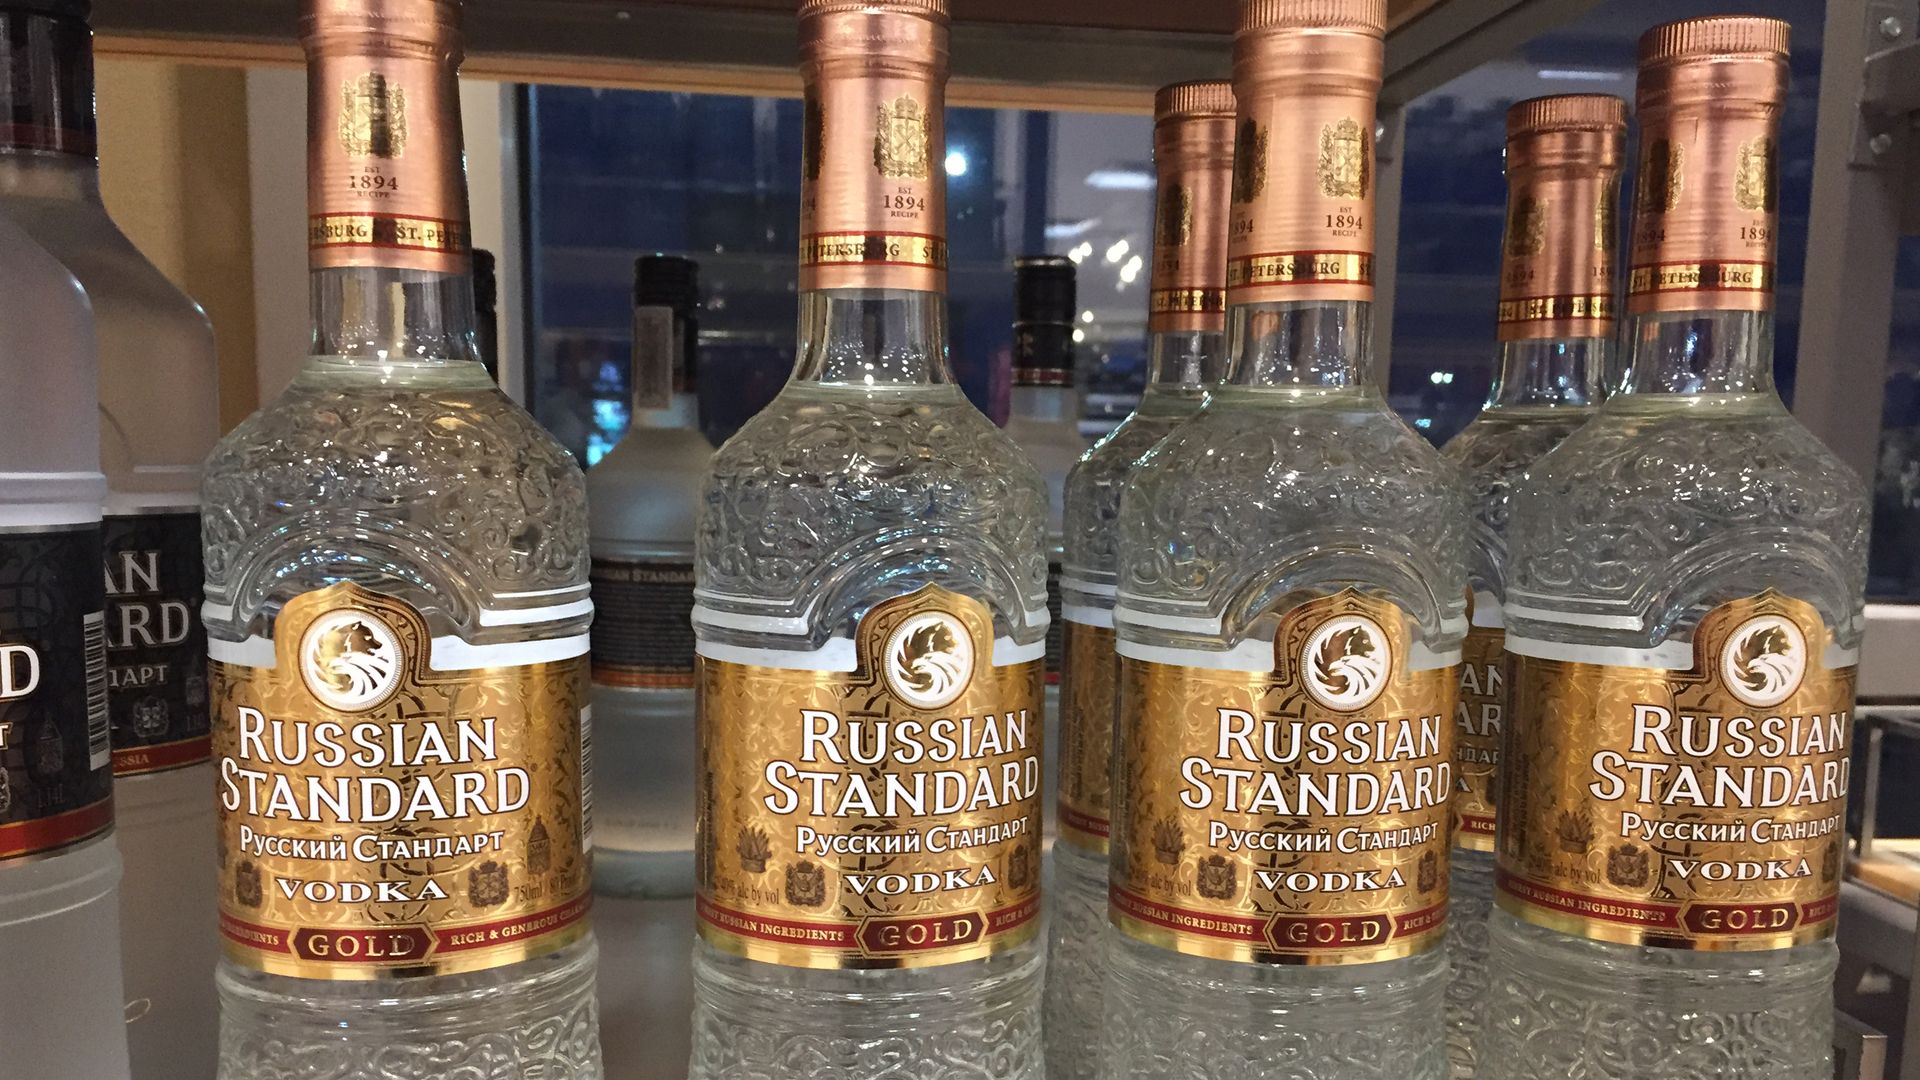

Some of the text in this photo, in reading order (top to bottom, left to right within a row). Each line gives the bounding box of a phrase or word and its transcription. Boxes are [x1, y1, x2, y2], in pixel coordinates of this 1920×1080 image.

[350, 175, 399, 190] 1894
[884, 195, 925, 211] 1894
[891, 210, 918, 218] RECIPE
[397, 226, 422, 241] ST.
[1326, 214, 1364, 230] 1894
[1332, 230, 1358, 238] RECIPE
[107, 602, 190, 648] RD
[238, 706, 498, 768] RUSSIAN
[800, 708, 1028, 765] RUSSIAN
[1216, 707, 1441, 765] RUSSIAN
[1629, 704, 1847, 758] RUSSIAN
[221, 757, 531, 823] STANDARD
[764, 755, 1040, 818] STANDARD
[1179, 756, 1451, 817] STANDARD
[1589, 750, 1850, 808] STANDARD
[844, 864, 997, 896] VODKA
[1255, 866, 1406, 893] VODKA
[1672, 857, 1813, 881] VODKA
[276, 878, 450, 904] VODKA
[751, 884, 761, 906] by
[765, 887, 780, 905] vol
[1533, 891, 1575, 908] RUSSIAN
[1578, 899, 1667, 923] INGREDIENTS
[1701, 908, 1789, 929] GOLD
[451, 913, 559, 946] RICH & GENEROUS
[760, 923, 845, 942] INGREDIENTS
[878, 918, 973, 946] GOLD
[1172, 913, 1254, 936] INGREDIENTS
[1287, 920, 1381, 943] GOLD
[308, 934, 415, 957] GOLD
